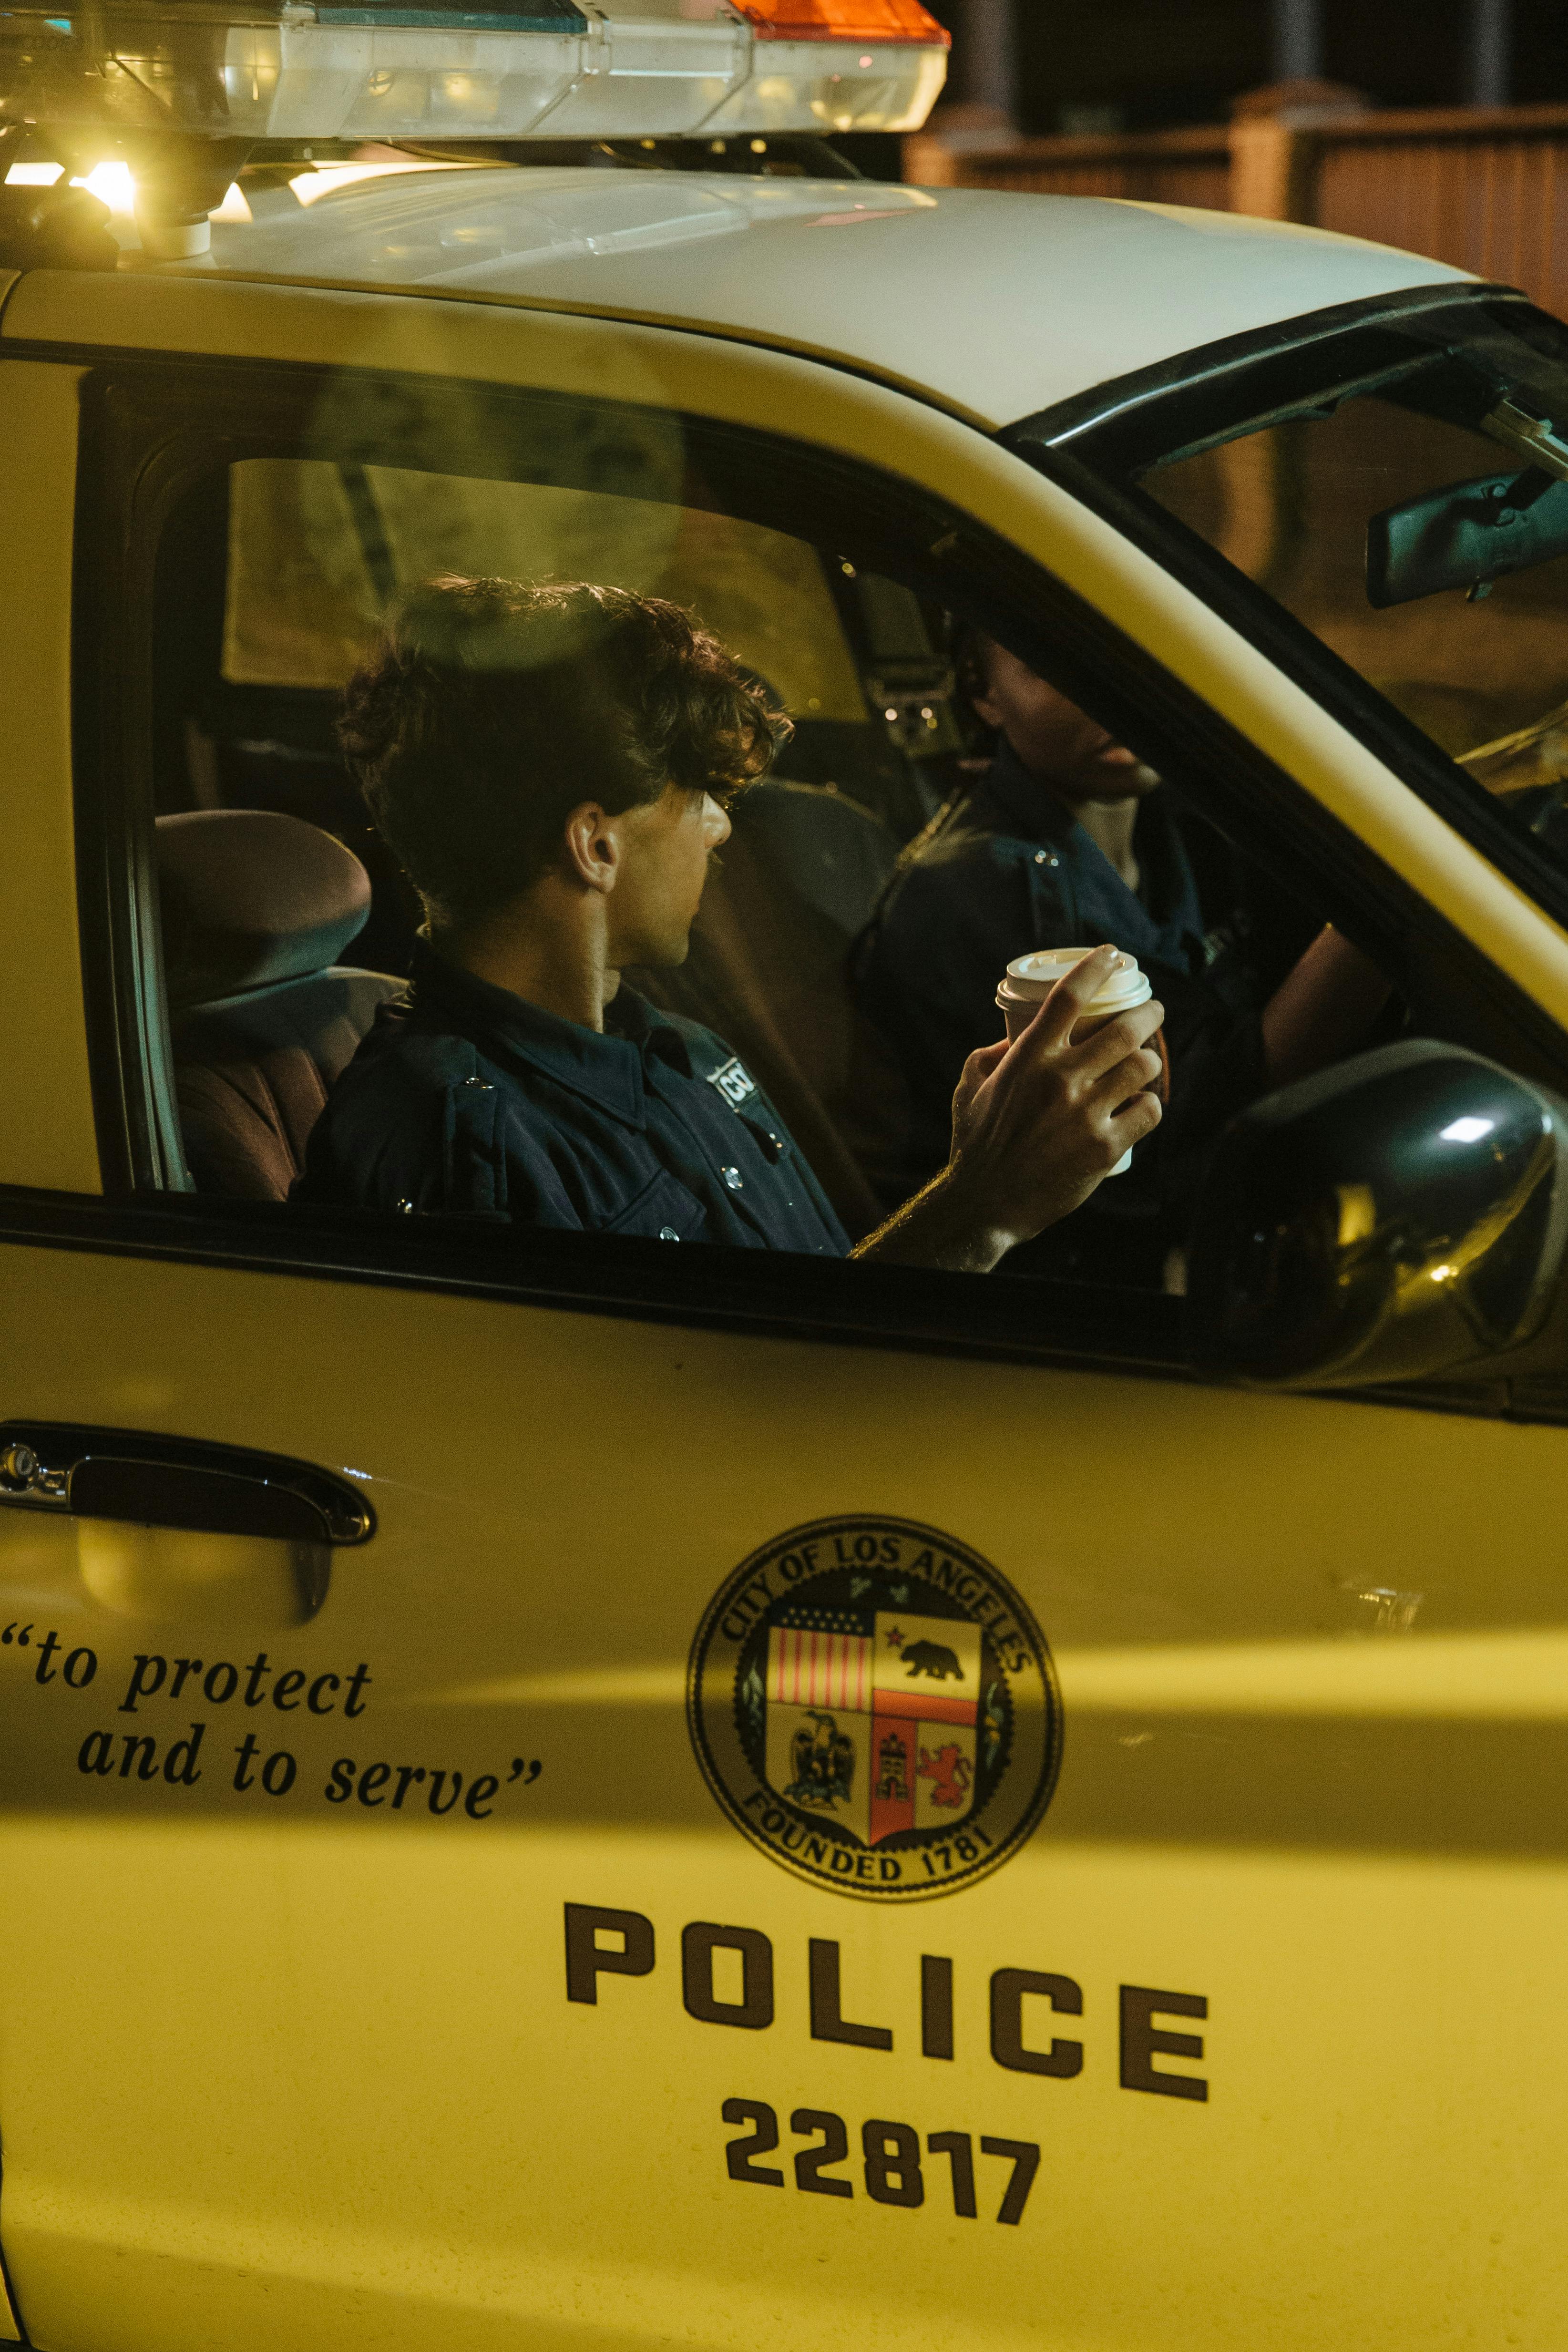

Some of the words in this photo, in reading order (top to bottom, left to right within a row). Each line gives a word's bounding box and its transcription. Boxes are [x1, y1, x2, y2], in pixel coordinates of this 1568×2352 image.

[721, 1574, 775, 1641] CITY
[779, 1543, 819, 1582] OF
[834, 1535, 901, 1563] LOS
[907, 1550, 1033, 1673] ANGELES
[118, 1653, 372, 1719] protect
[77, 1723, 205, 1787] and
[233, 1734, 297, 1798] to
[324, 1757, 543, 1820] serve”
[744, 1791, 901, 1880] FOUNDED
[922, 1826, 992, 1876] 1781
[563, 1901, 1209, 2104] POLICE
[720, 2096, 1042, 2227] 22817
